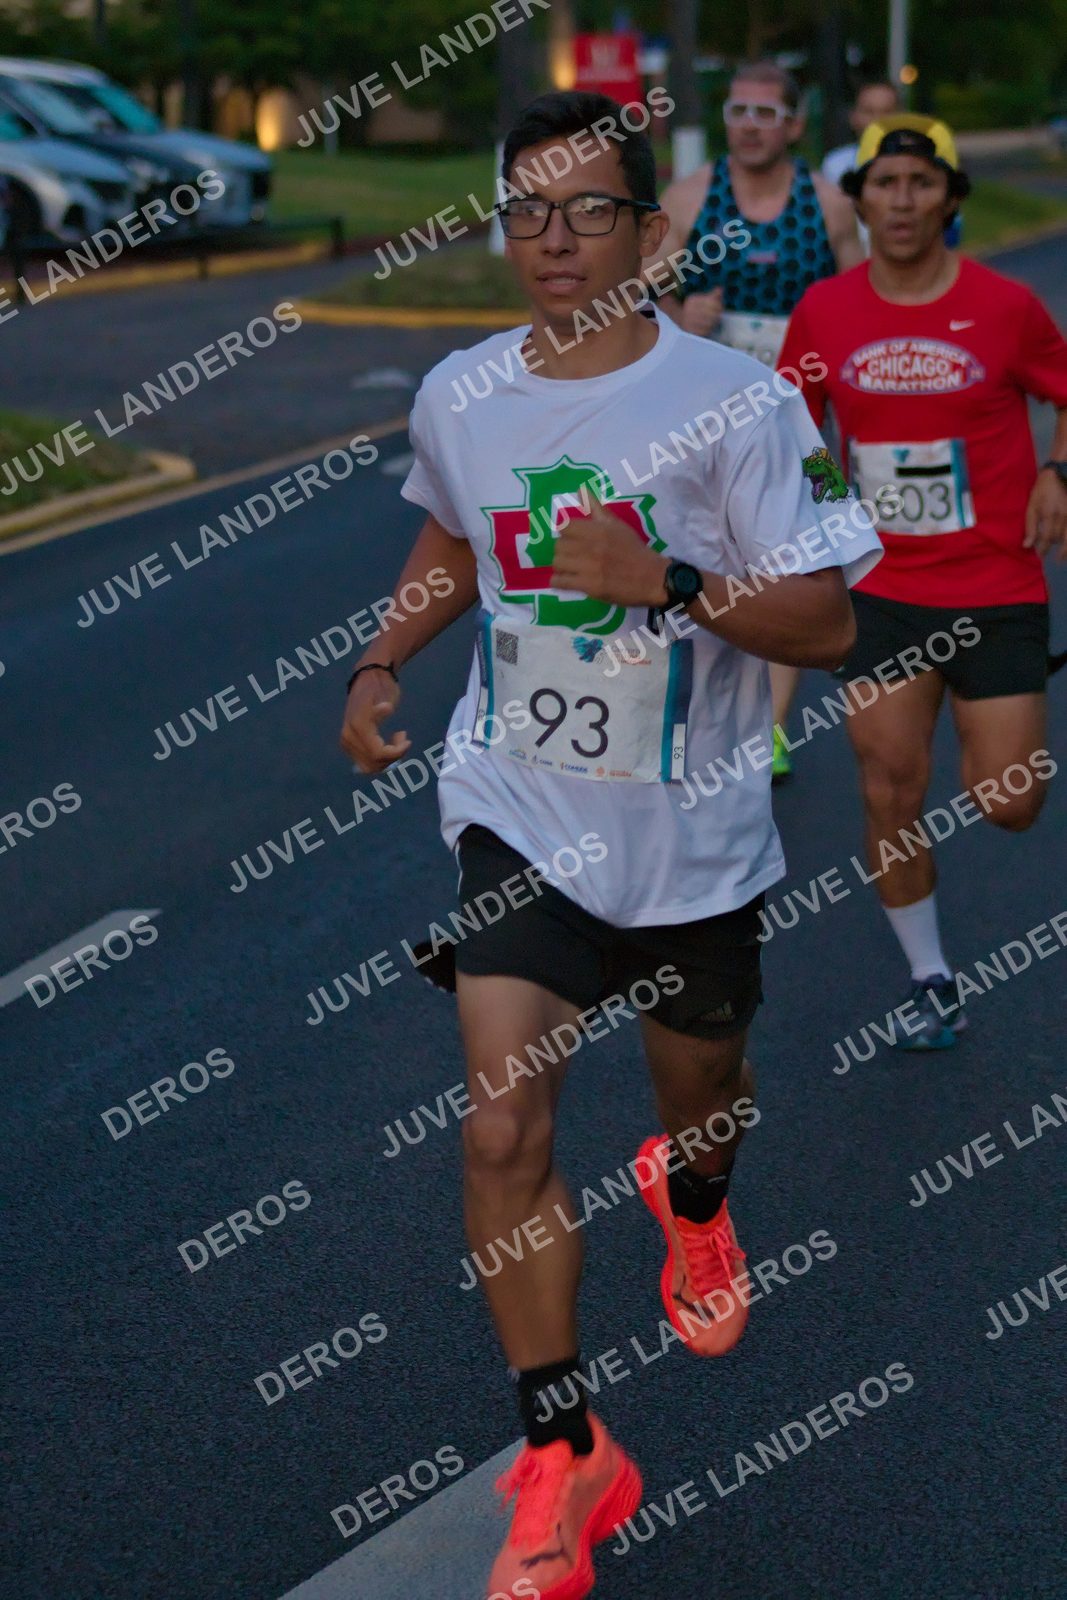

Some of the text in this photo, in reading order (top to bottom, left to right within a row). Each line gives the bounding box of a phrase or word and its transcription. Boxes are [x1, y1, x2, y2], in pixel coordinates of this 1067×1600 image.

[866, 354, 950, 378] CHICAGO
[858, 370, 962, 391] MARATHON
[528, 688, 610, 758] 93
[673, 746, 685, 761] 93
